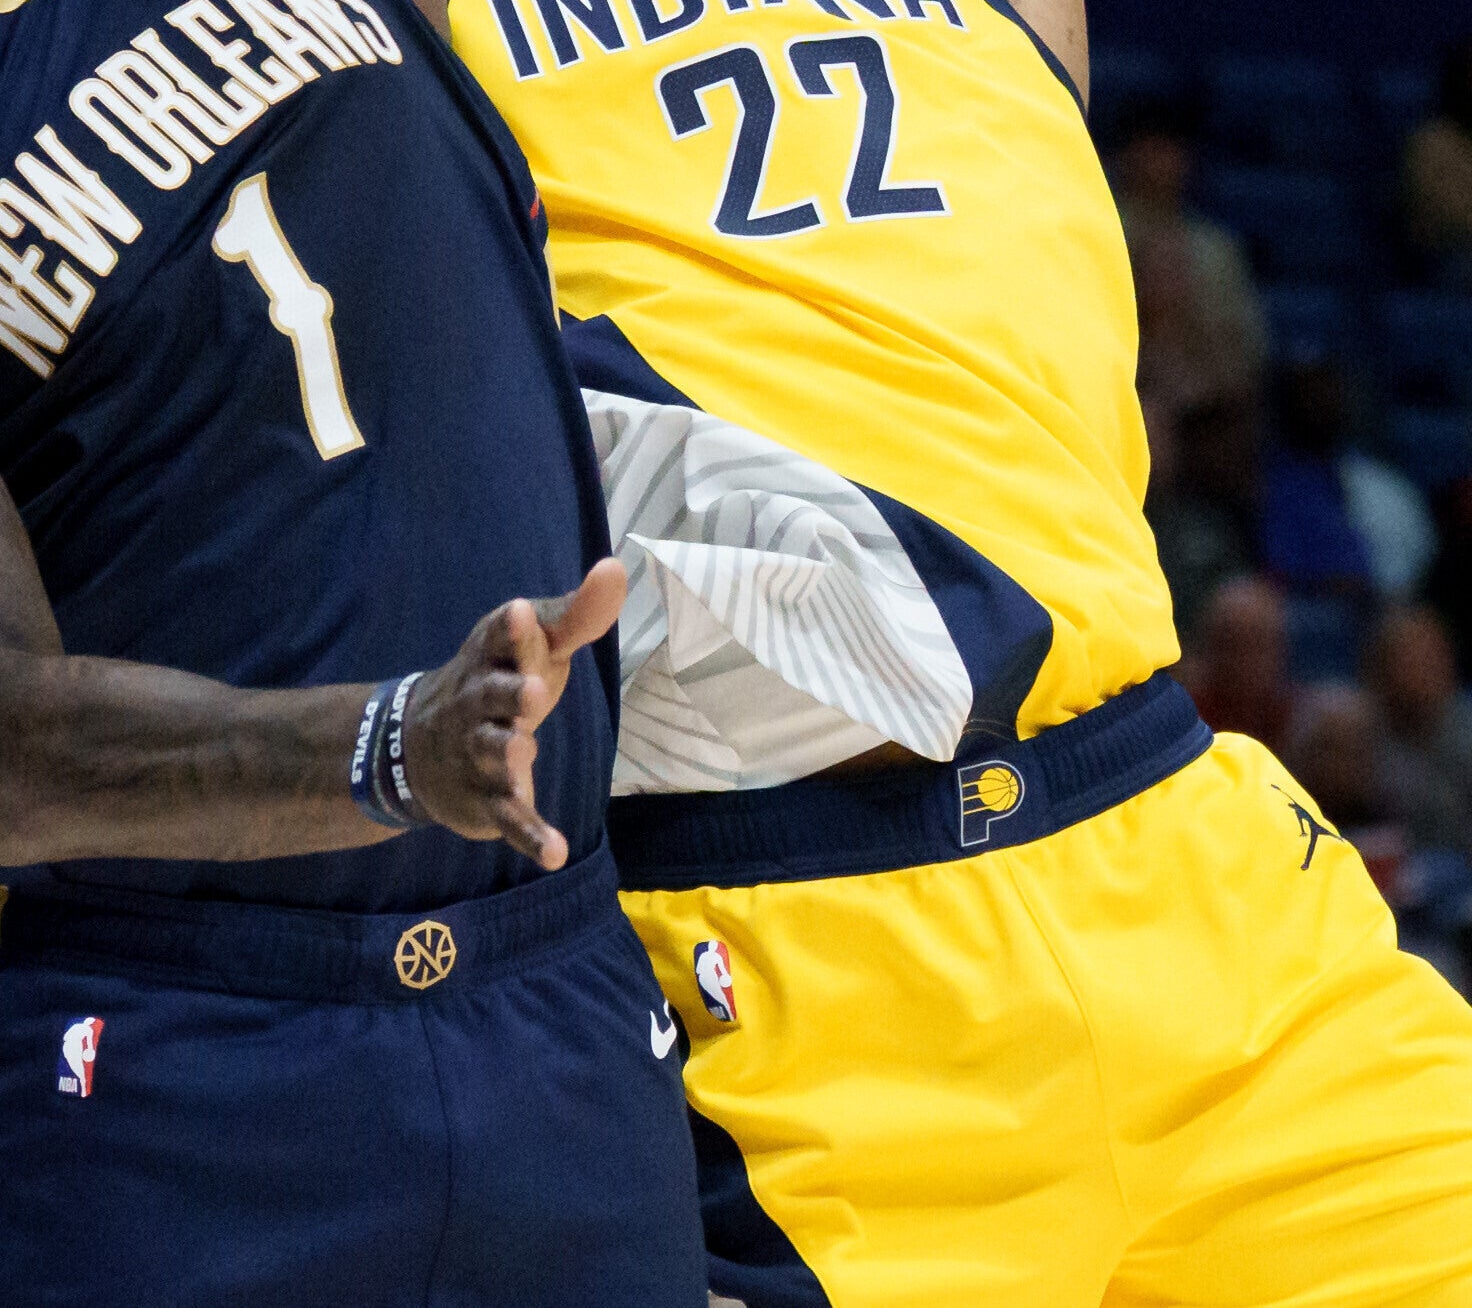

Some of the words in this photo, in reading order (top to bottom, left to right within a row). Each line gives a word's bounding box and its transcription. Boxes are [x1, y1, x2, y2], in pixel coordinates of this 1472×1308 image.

[655, 28, 951, 241] 22
[212, 171, 367, 462] 1
[389, 727, 402, 759] TO
[391, 764, 412, 801] DIE
[58, 1076, 78, 1093] NBA
